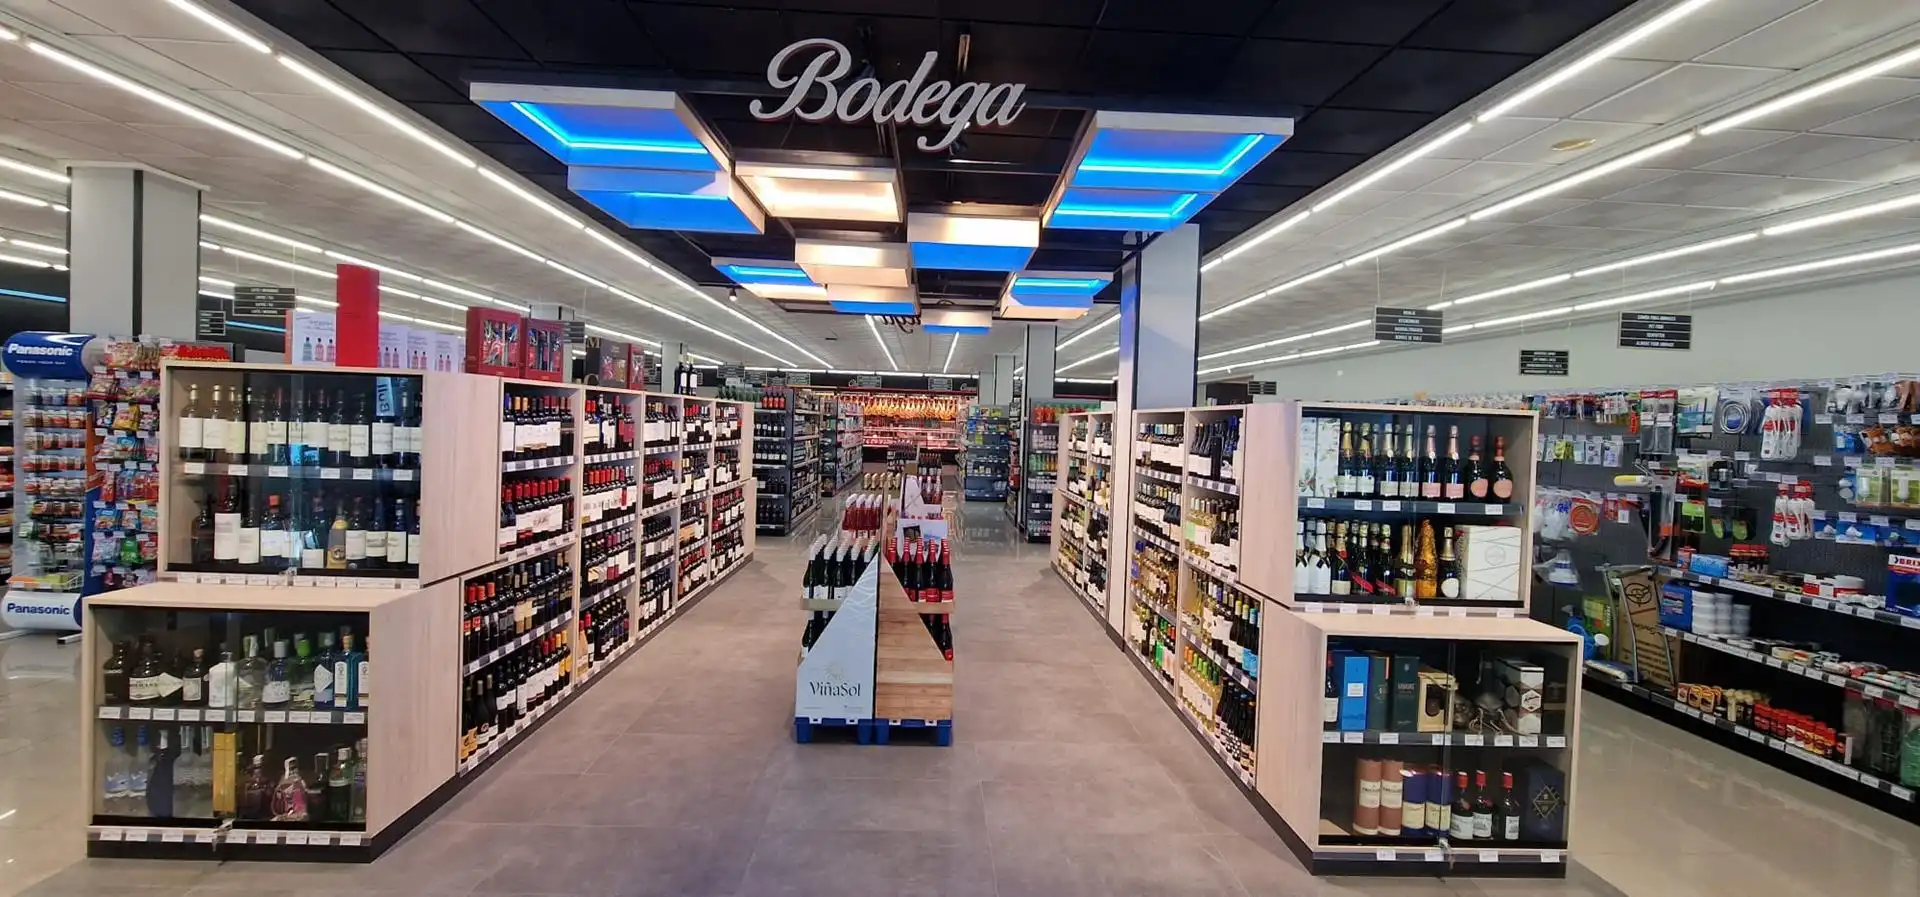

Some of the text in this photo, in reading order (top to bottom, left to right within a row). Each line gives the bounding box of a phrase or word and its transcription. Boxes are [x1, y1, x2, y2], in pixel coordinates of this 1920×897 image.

[749, 38, 1027, 153] Bodega
[7, 343, 73, 356] Panasonic
[7, 602, 70, 615] Panasonic
[809, 681, 861, 697] ViñaSol
